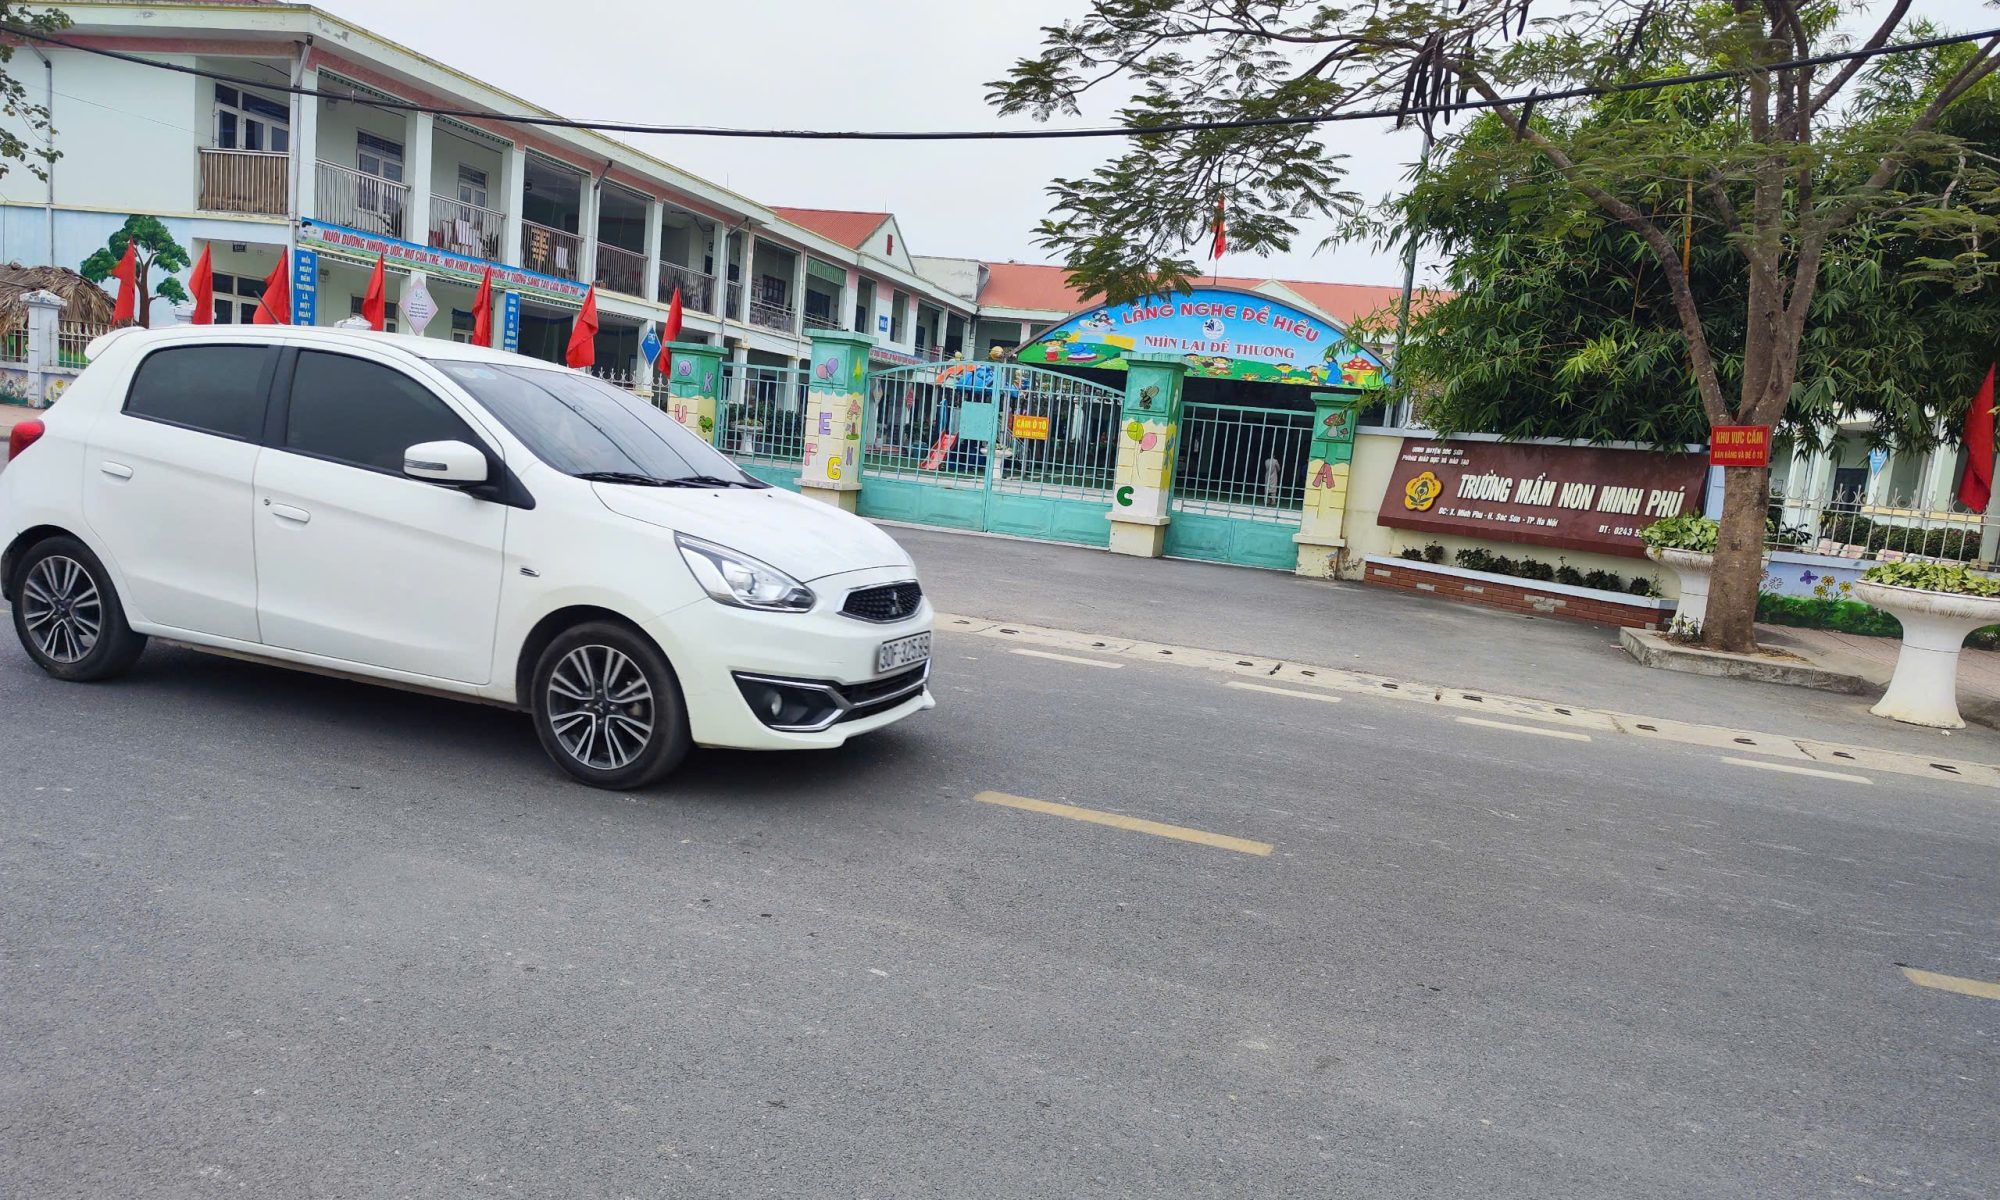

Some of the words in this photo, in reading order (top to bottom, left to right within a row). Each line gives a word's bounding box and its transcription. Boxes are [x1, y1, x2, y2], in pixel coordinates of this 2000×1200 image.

[1122, 303, 1174, 325] LẮNG
[1180, 302, 1236, 318] NGHE
[1273, 319, 1321, 343] HIỂU
[1144, 335, 1178, 349] NHÌN
[1181, 340, 1205, 354] LẠI
[819, 411, 832, 436] E
[1716, 431, 1730, 445] KHU
[1747, 428, 1763, 445] CẤM
[804, 442, 818, 467] F
[827, 456, 842, 480] G
[1312, 463, 1335, 489] A
[1117, 486, 1134, 507] C
[1457, 469, 1513, 503] TRƯỜNG
[1514, 472, 1557, 507] MẦM
[1557, 482, 1596, 511] NON
[1596, 486, 1644, 515] MINH
[1644, 486, 1686, 518] PHÚ
[1613, 526, 1633, 536] 0243
